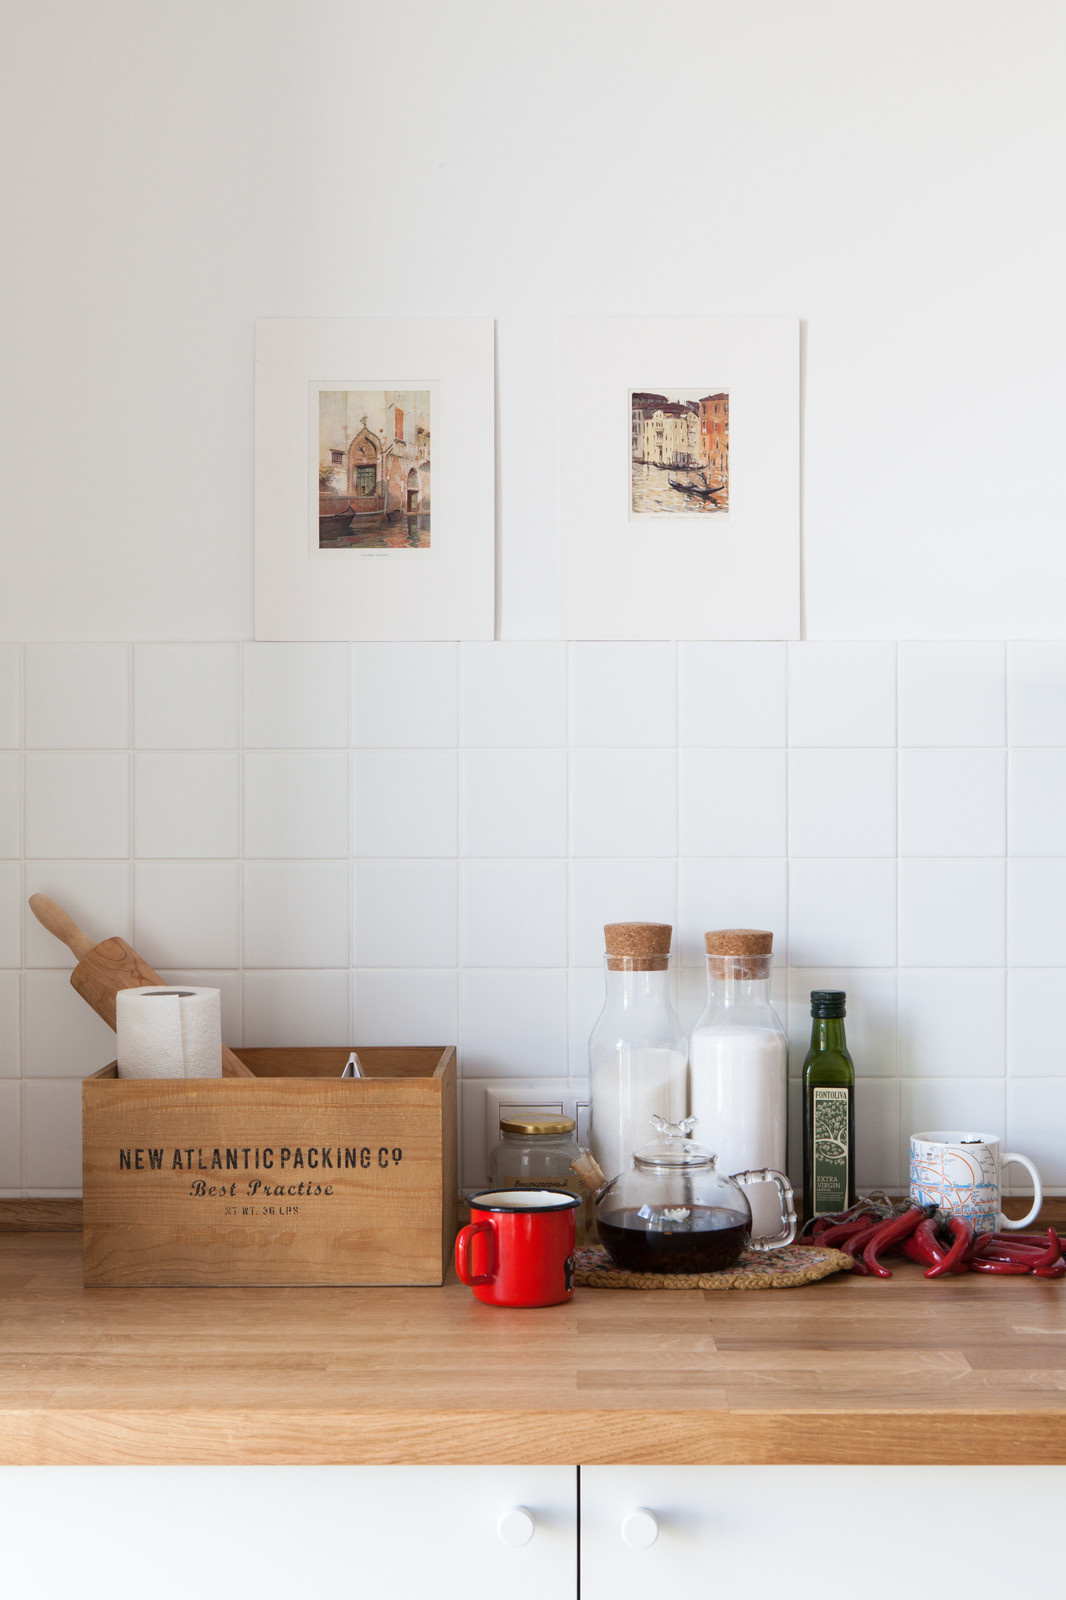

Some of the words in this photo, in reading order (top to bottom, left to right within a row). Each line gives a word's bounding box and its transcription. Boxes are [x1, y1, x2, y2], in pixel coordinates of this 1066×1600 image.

[815, 1090, 847, 1100] FONTOLIVA
[119, 1148, 164, 1170] NEW
[172, 1147, 274, 1170] ATLANTIC
[280, 1147, 371, 1169] PACKING
[189, 1179, 236, 1197] Best
[246, 1179, 334, 1197] Practise
[514, 1179, 568, 1188] Высокогорный
[225, 1206, 238, 1216] NT
[262, 1206, 275, 1216] 36
[279, 1206, 299, 1216] LBS
